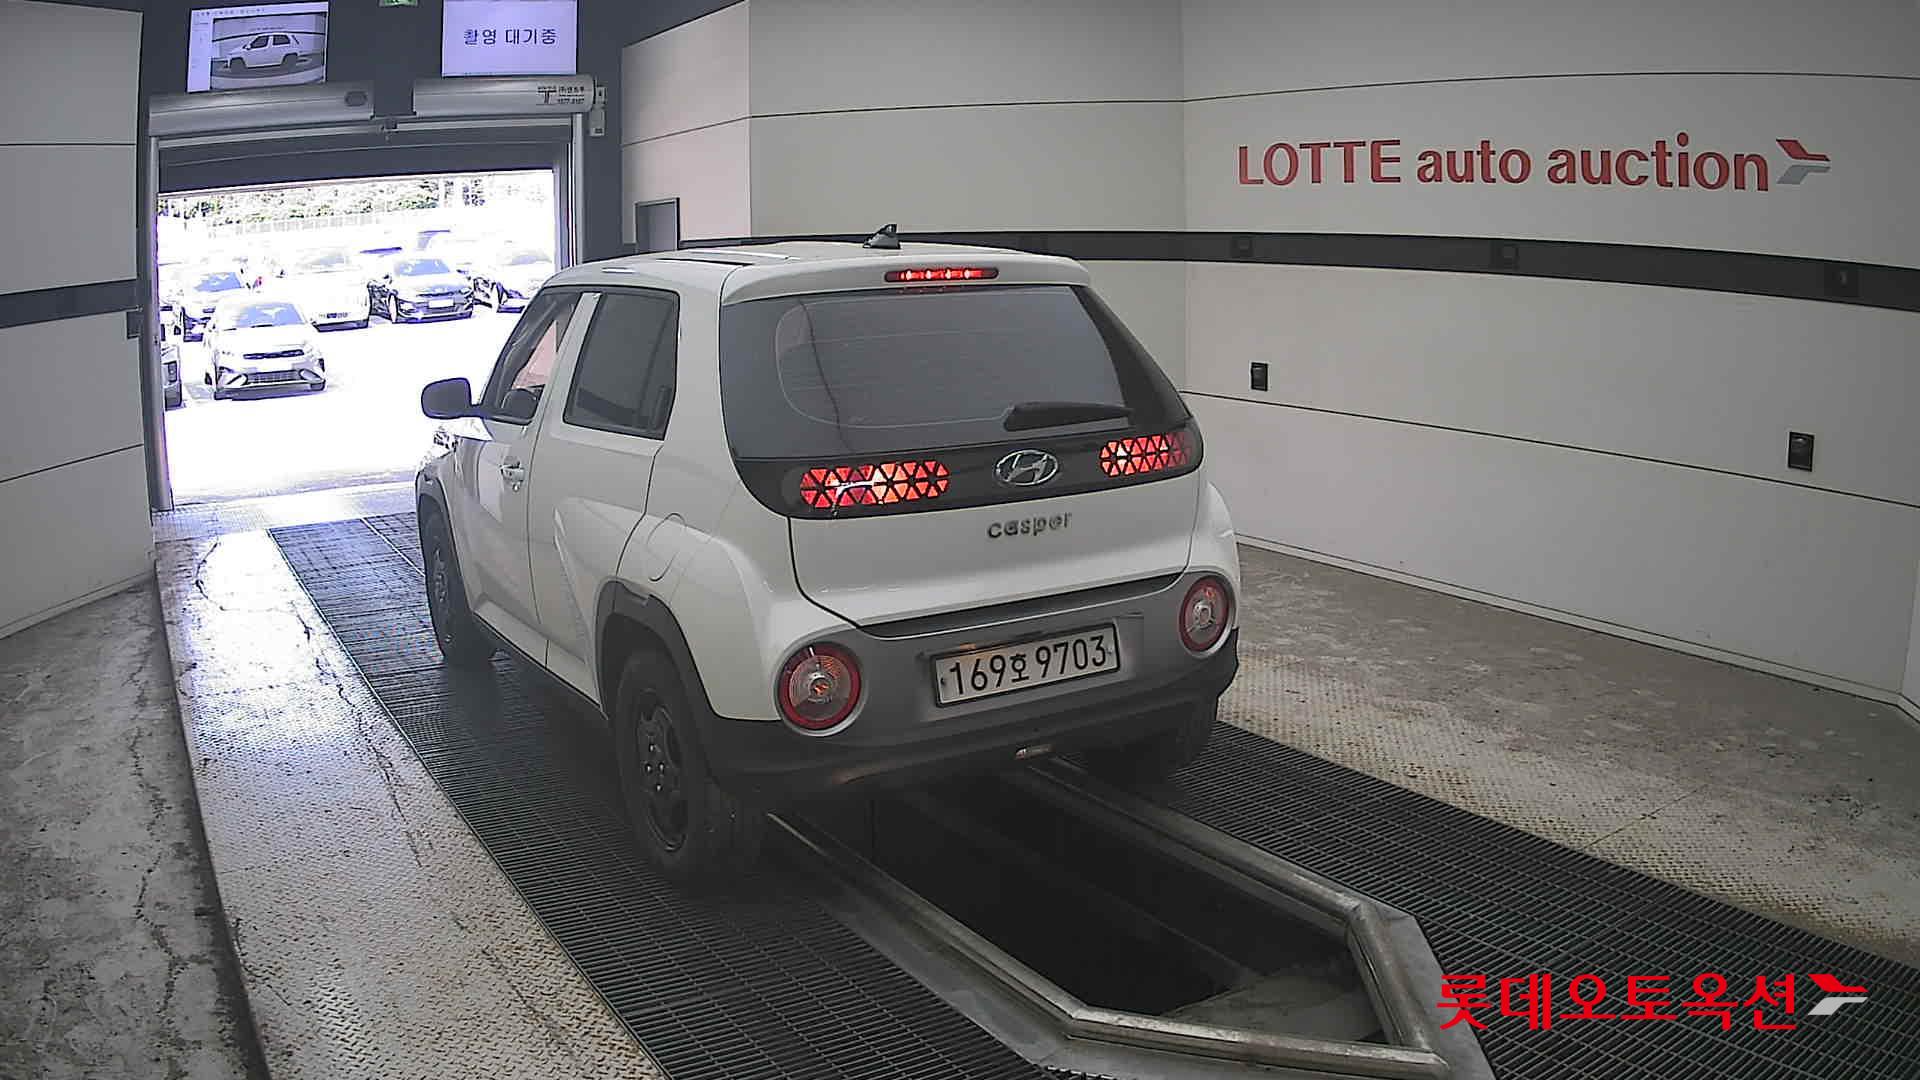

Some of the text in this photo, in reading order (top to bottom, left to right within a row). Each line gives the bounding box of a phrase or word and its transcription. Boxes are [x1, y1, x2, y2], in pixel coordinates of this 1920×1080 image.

[463, 28, 557, 45] 촬영 대기중
[1238, 131, 1769, 191] LOTTE auto auction
[986, 512, 1073, 539] casper
[1035, 634, 1107, 678] 9703
